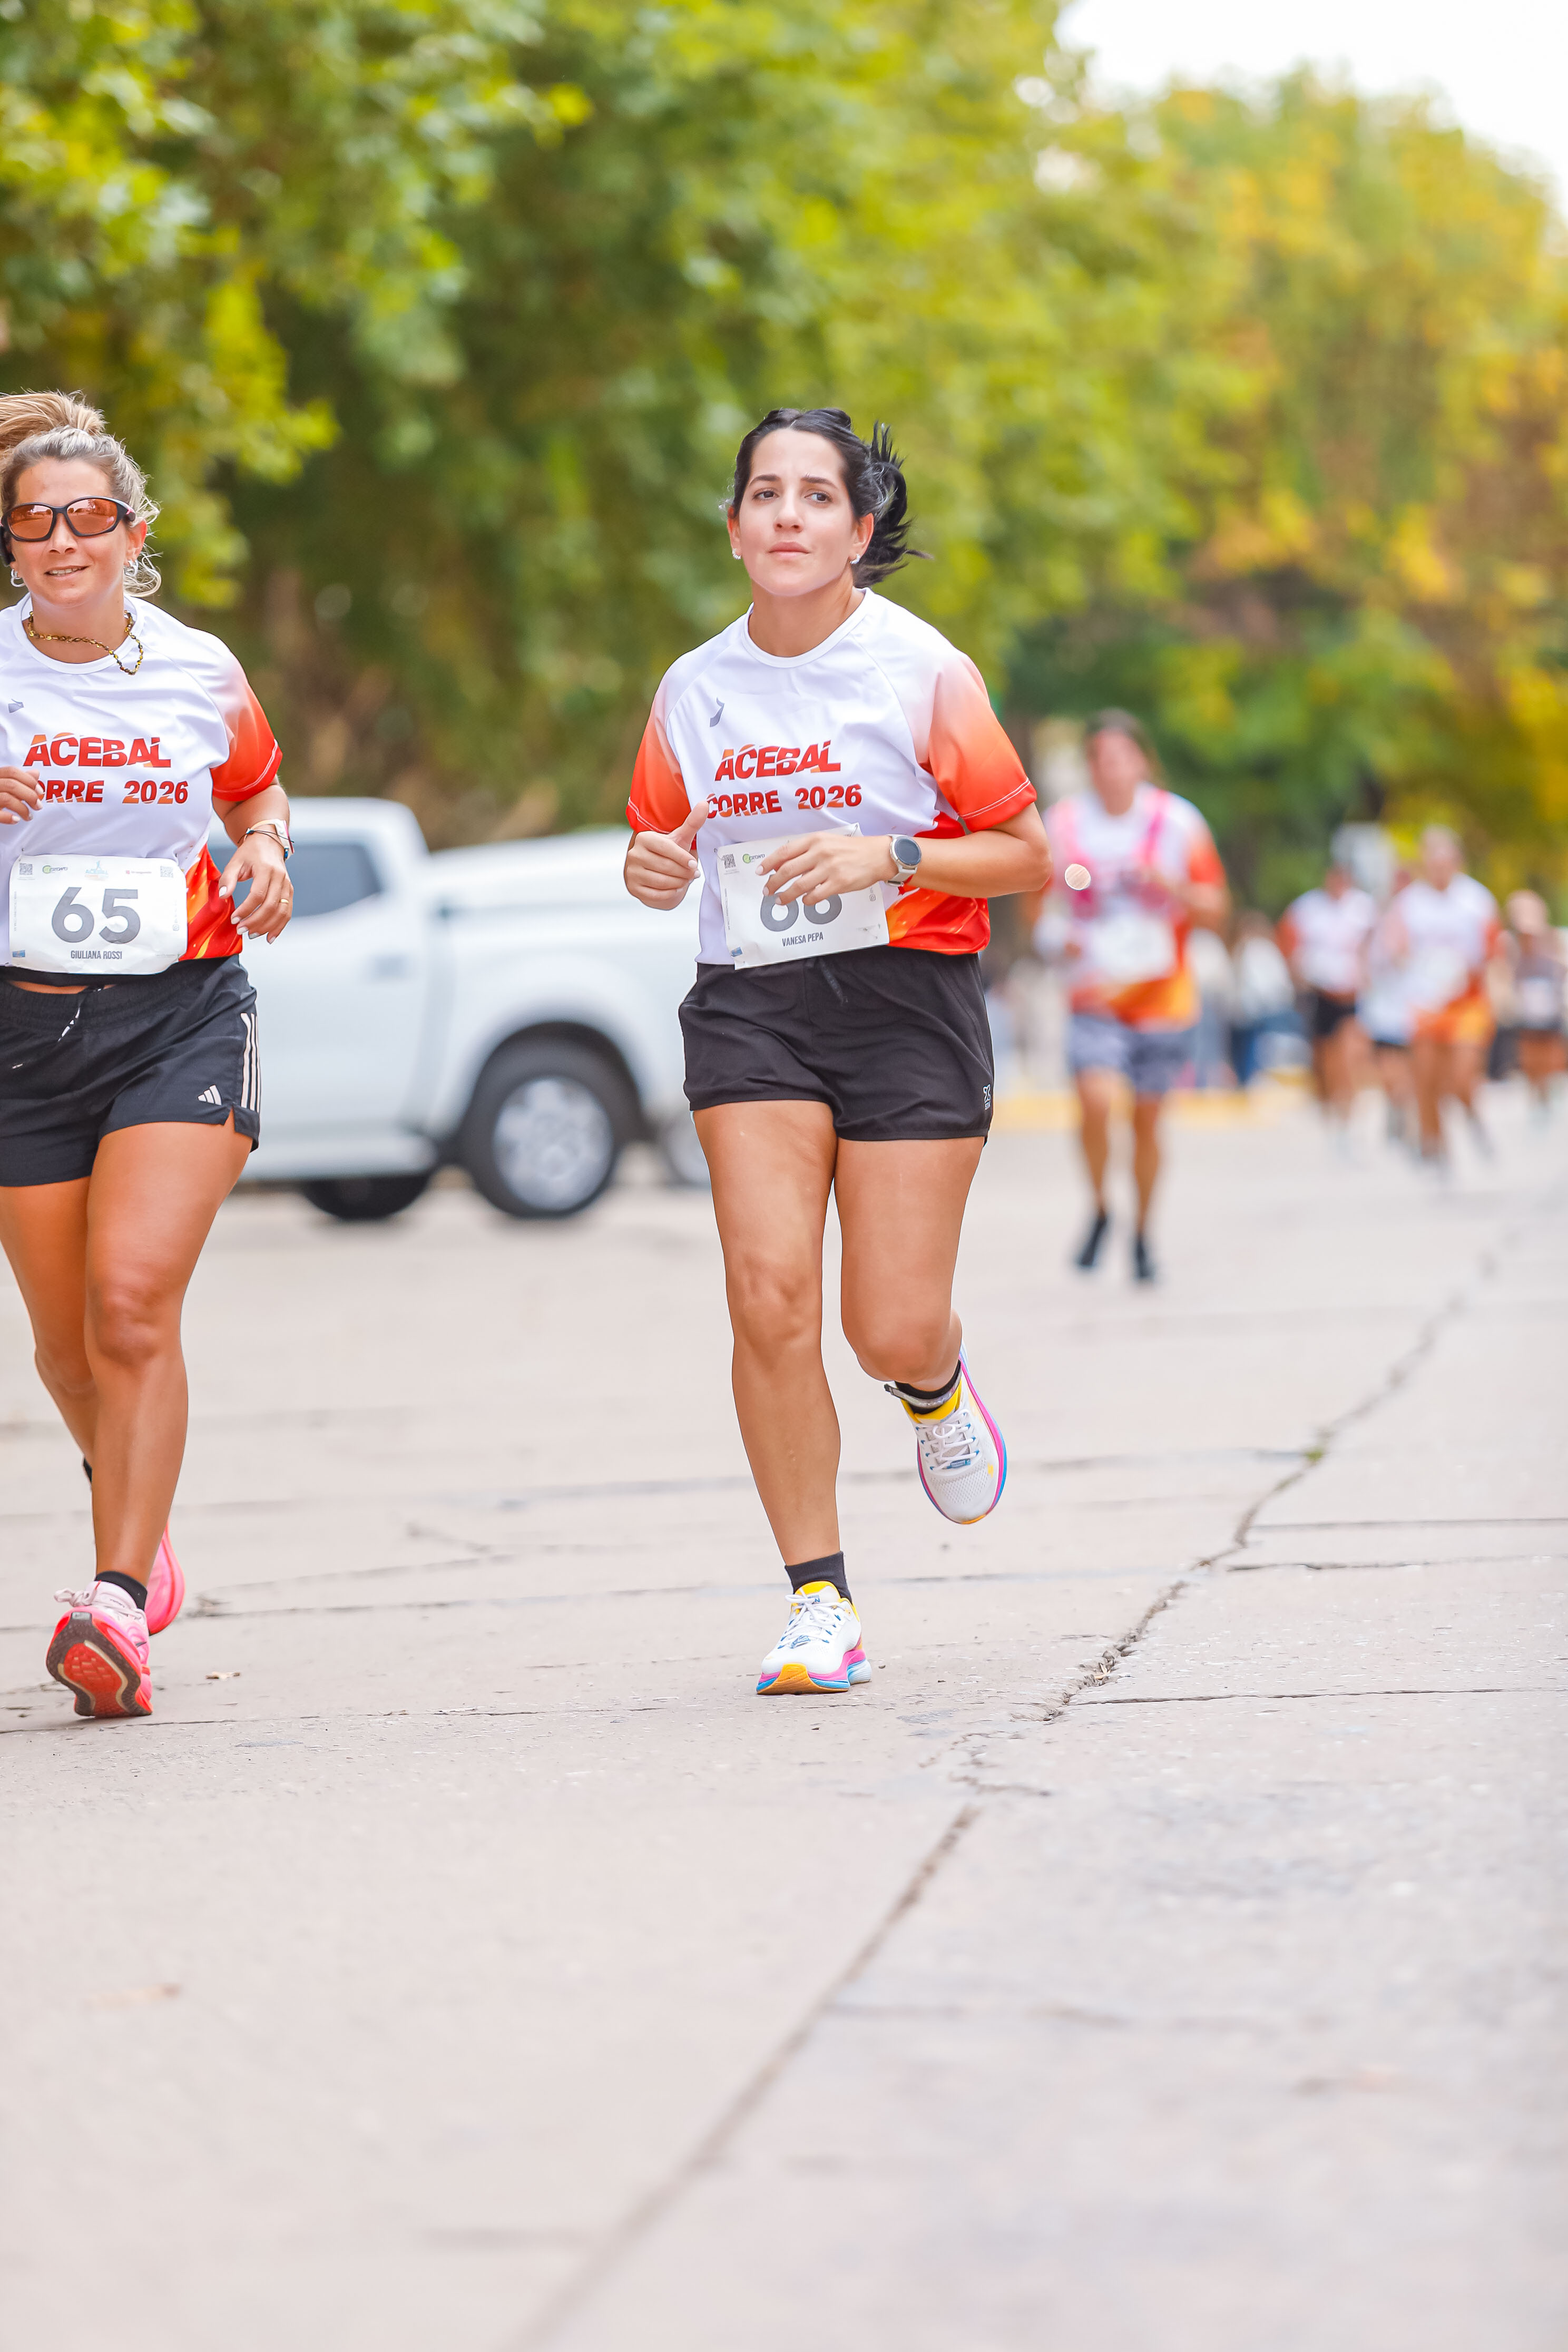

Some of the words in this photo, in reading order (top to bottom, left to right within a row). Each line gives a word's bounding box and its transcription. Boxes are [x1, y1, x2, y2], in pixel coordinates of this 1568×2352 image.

[23, 732, 171, 768] ACEBAL
[715, 740, 841, 781] ACEBAL
[38, 780, 104, 802] RRE
[122, 780, 188, 804] 2026
[707, 790, 782, 818] CORRE
[795, 784, 862, 810] 2026
[52, 887, 141, 944] 65
[71, 950, 102, 959] GIULIANA
[103, 950, 122, 959] ROSSI
[782, 934, 807, 947] VANESA
[808, 932, 824, 942] PEPA
